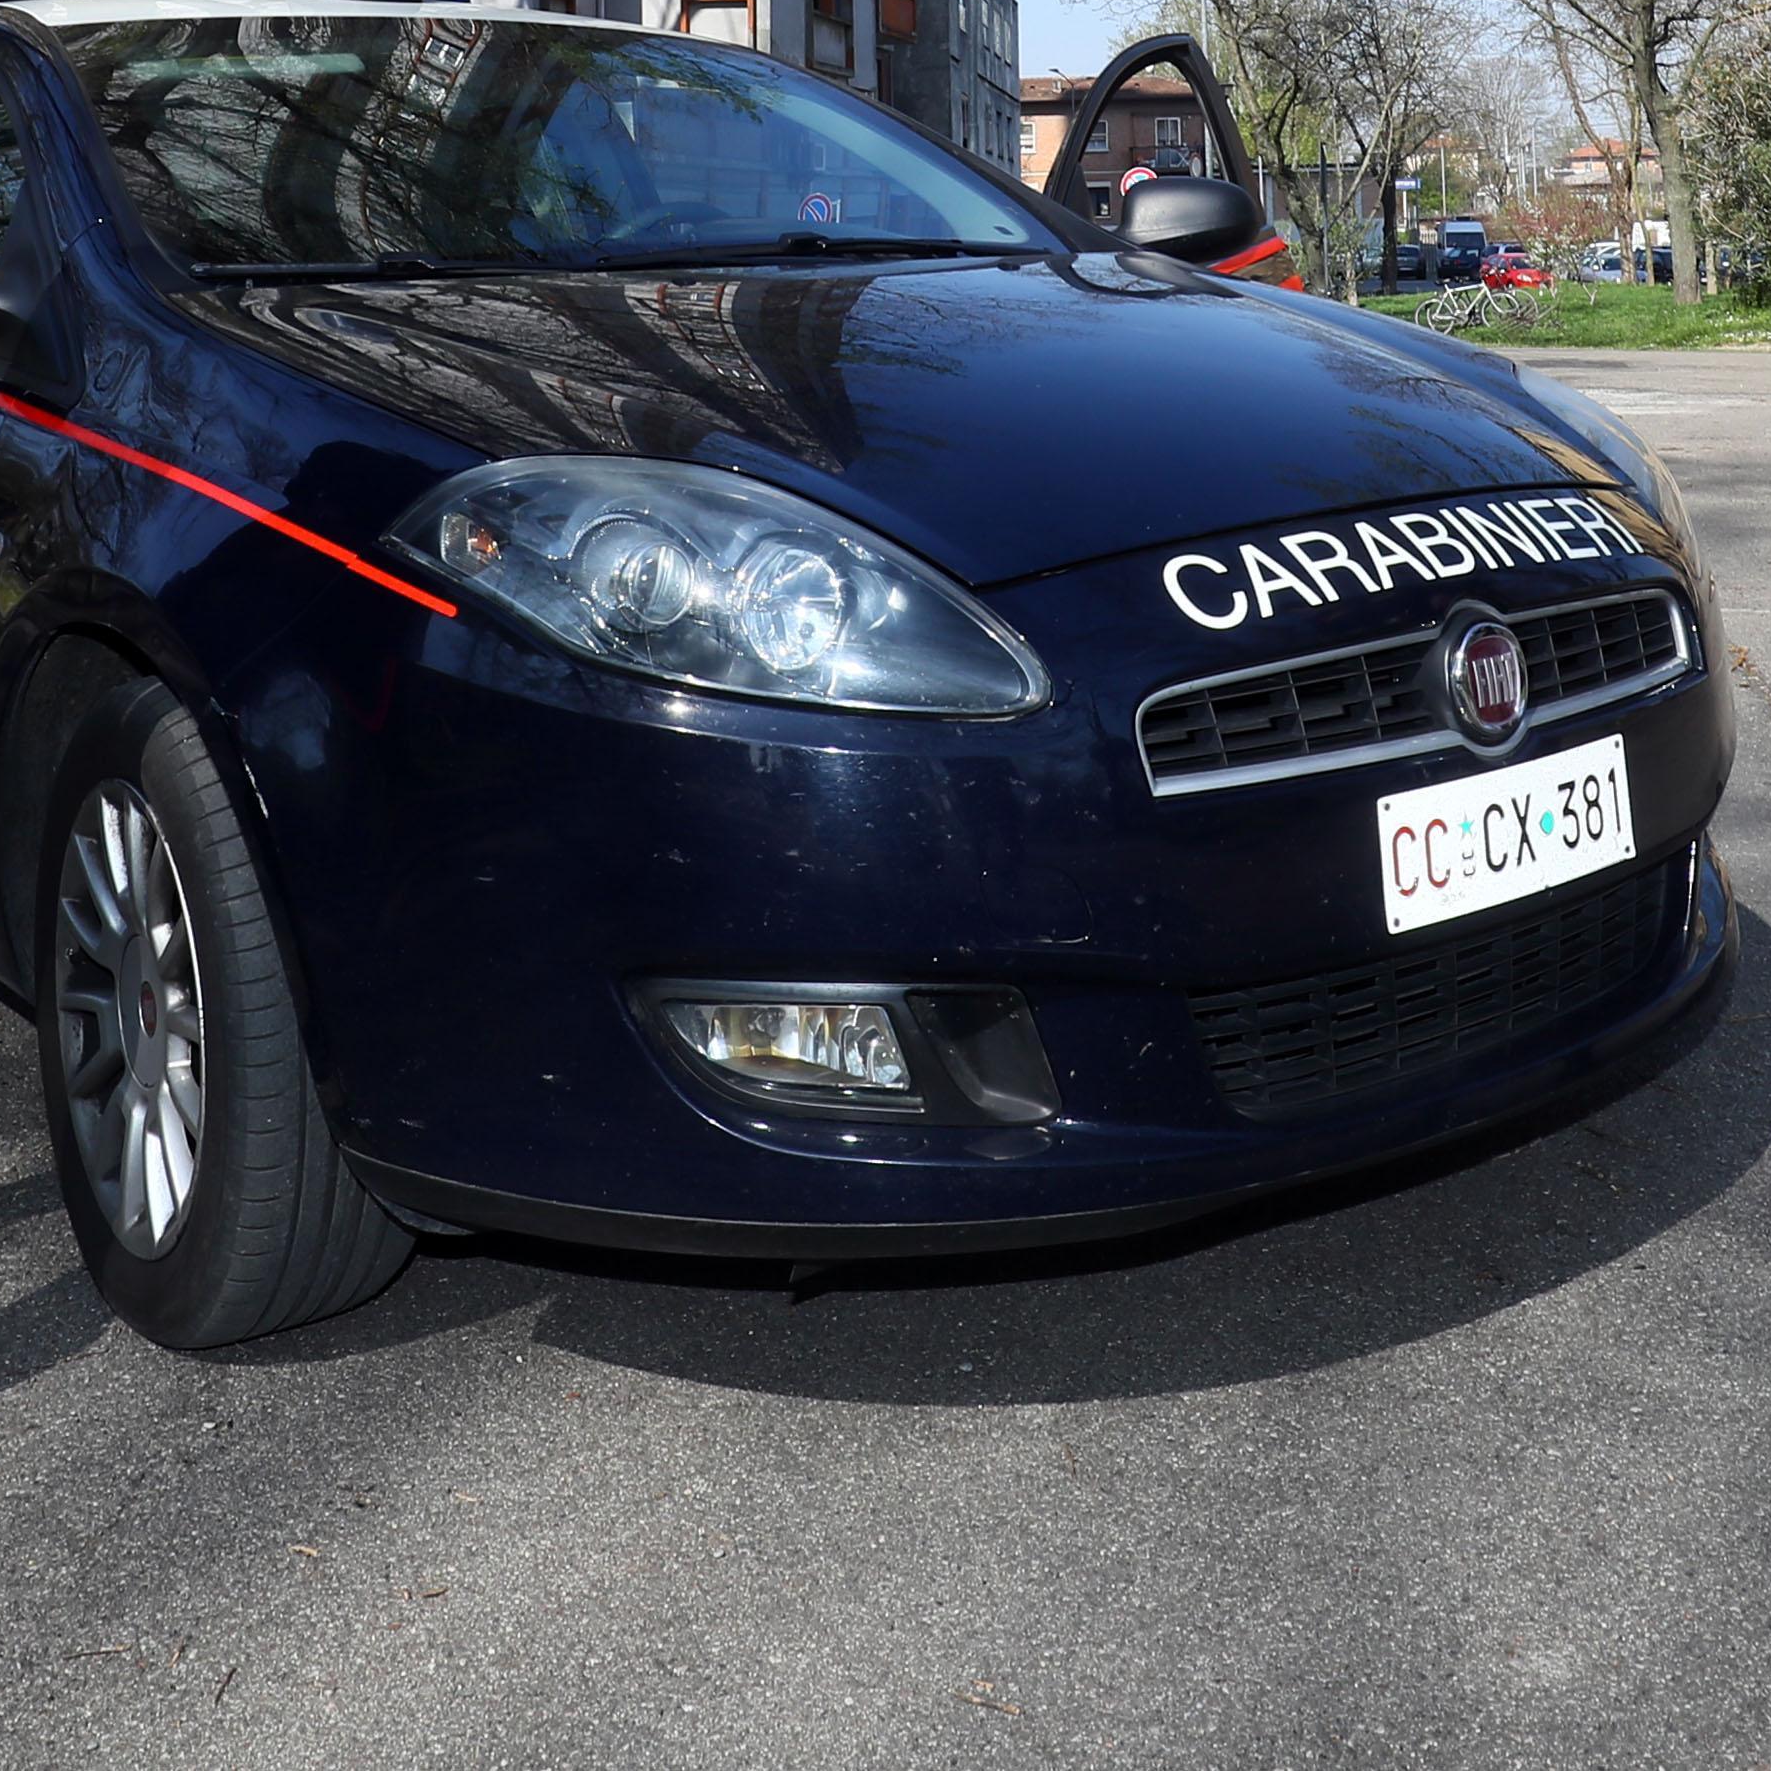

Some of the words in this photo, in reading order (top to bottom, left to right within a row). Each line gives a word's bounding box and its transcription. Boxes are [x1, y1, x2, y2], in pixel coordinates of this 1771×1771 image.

[1162, 497, 1644, 630] CARABINIERI
[1471, 652, 1514, 708] FIAT
[1392, 819, 1451, 897] CC
[1483, 794, 1536, 873] CX
[1557, 768, 1621, 849] 381
